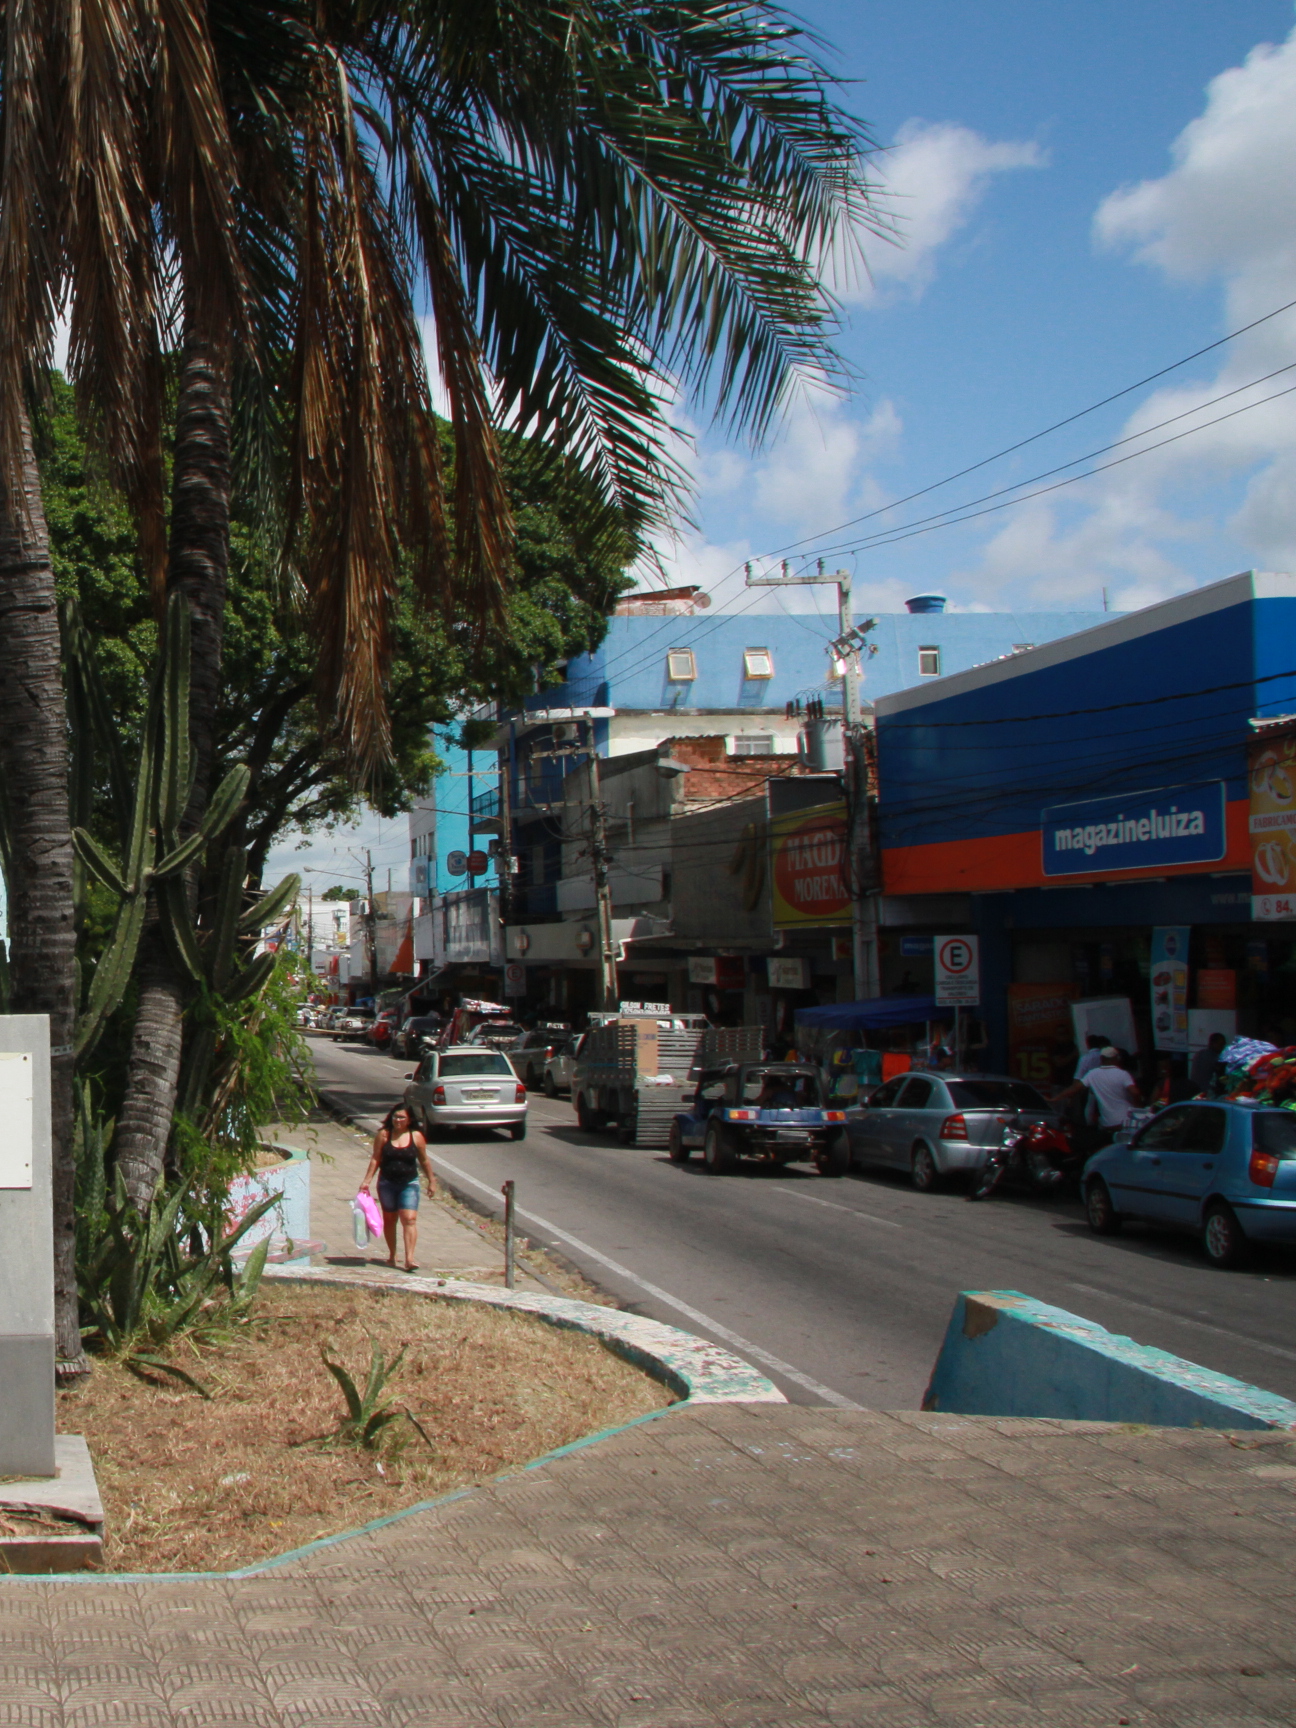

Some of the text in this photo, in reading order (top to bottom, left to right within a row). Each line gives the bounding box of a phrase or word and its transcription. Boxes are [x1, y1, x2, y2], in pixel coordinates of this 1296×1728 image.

[1054, 806, 1205, 855] magazineluiza
[786, 830, 848, 871] MAGD
[950, 946, 963, 966] E
[644, 1002, 670, 1011] FRETES
[1016, 1052, 1050, 1079] 15
